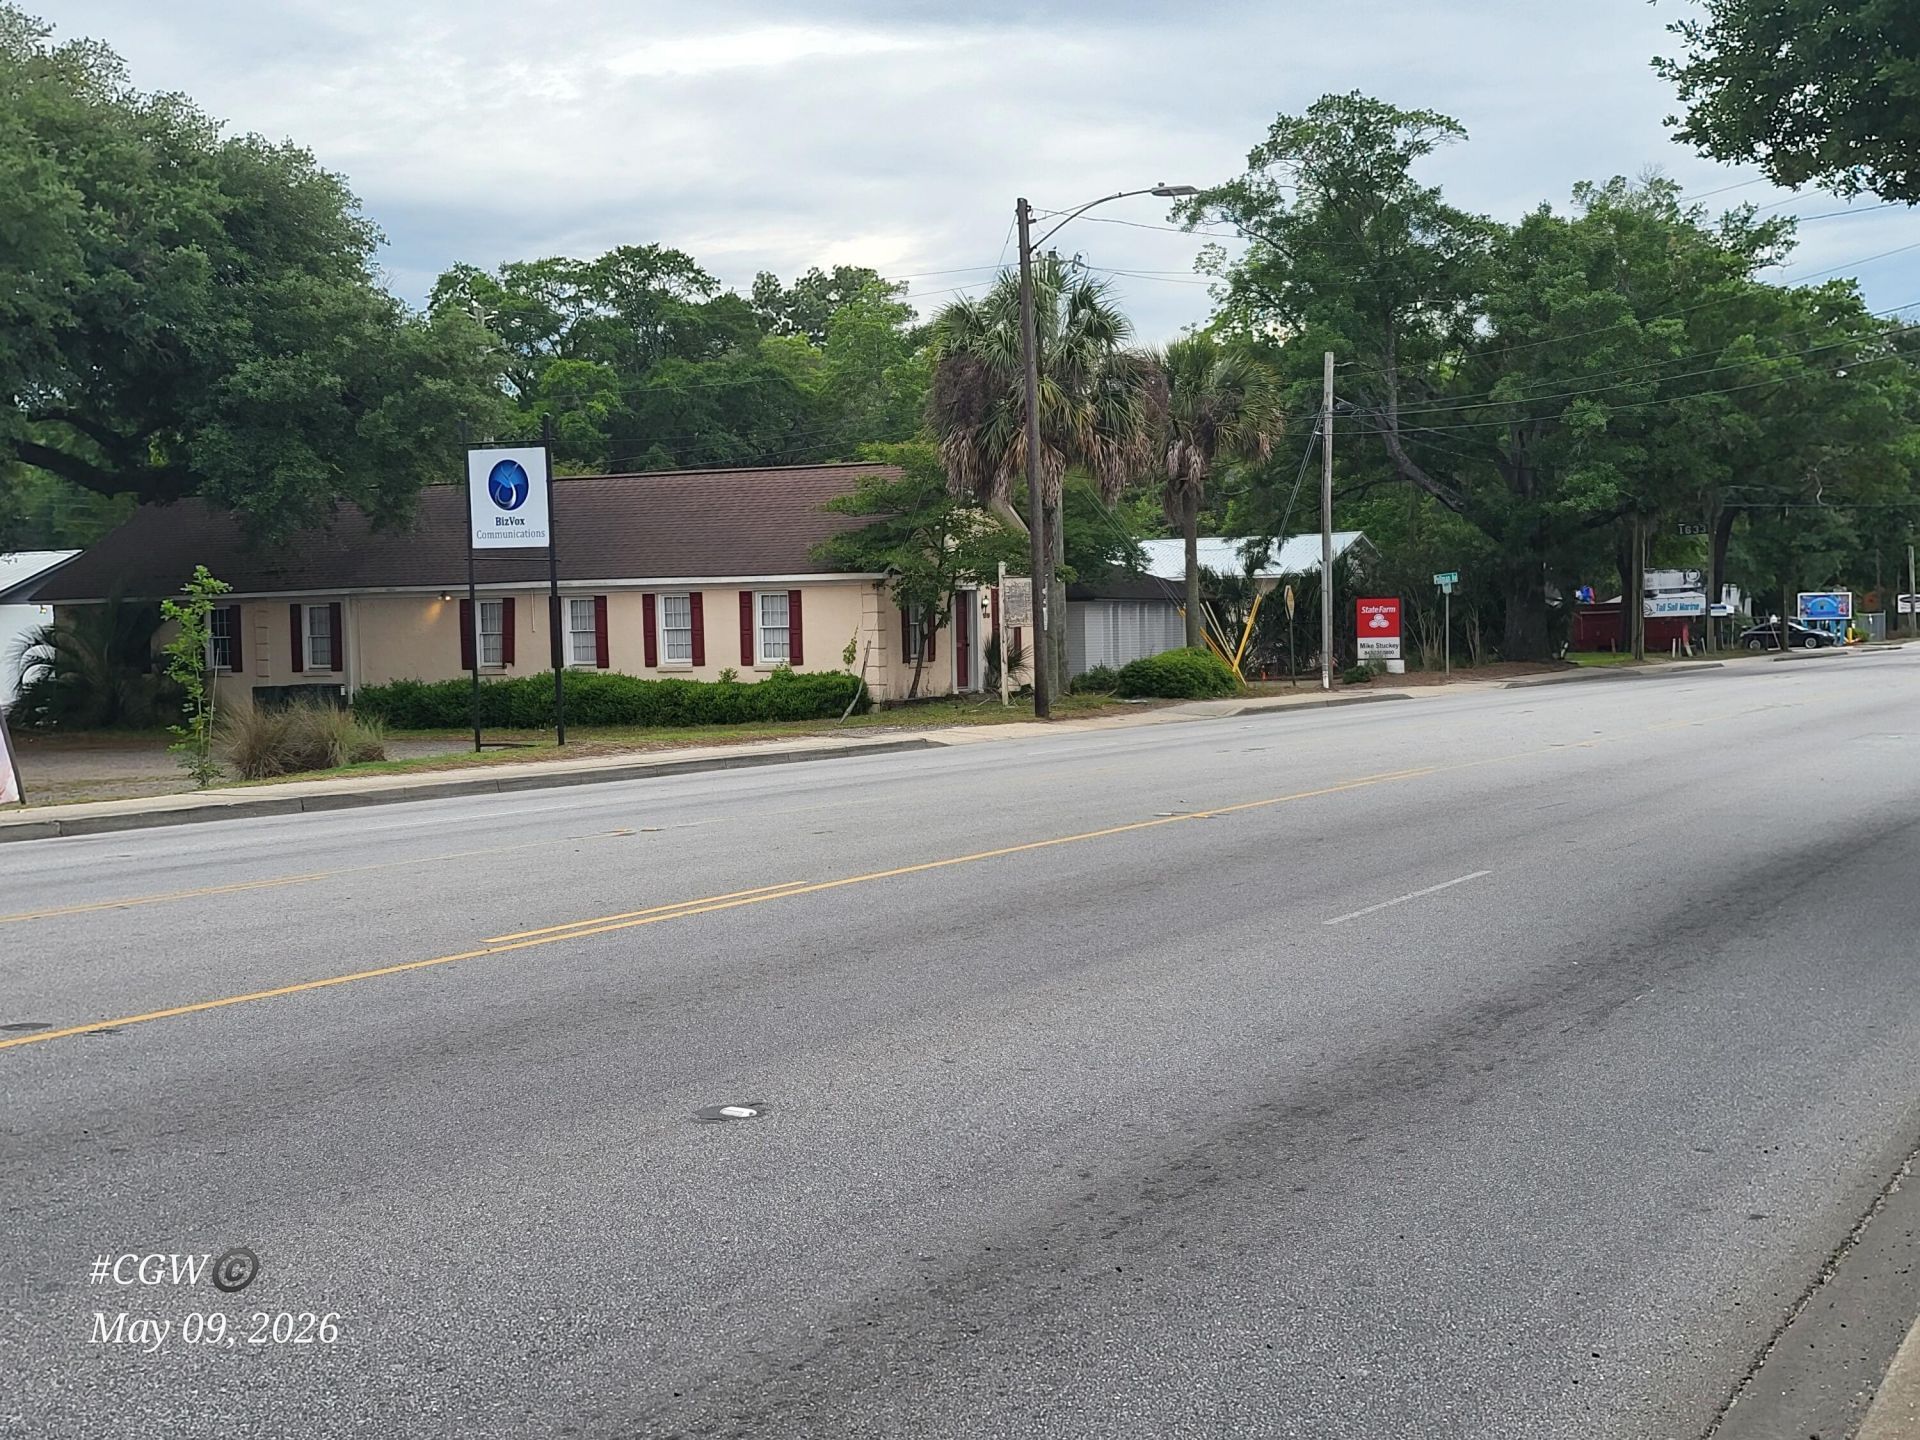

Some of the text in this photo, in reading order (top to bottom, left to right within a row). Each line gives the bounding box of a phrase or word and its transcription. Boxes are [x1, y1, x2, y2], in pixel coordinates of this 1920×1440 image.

[495, 516, 525, 526] BizVox
[476, 529, 546, 540] Communications
[1679, 602, 1700, 611] Marine
[1376, 642, 1399, 650] Stuckey
